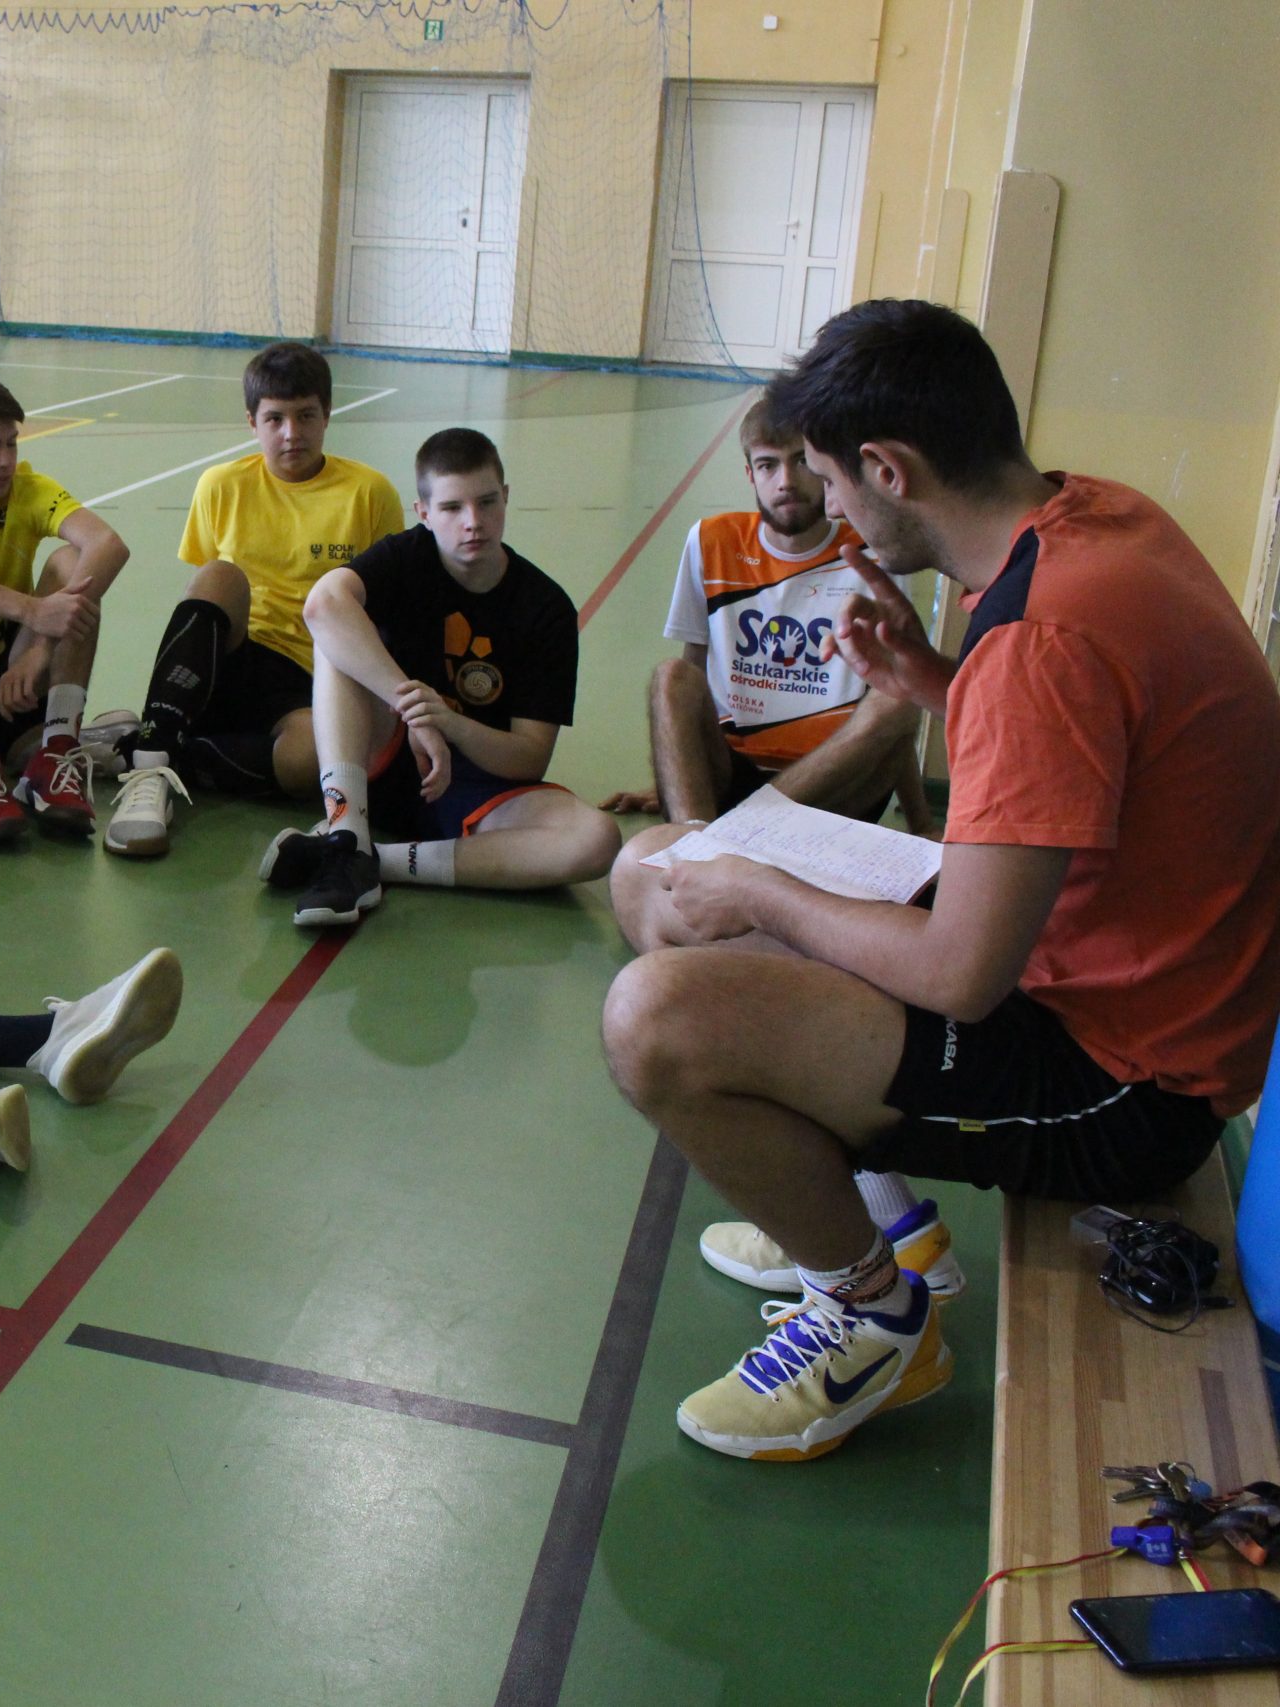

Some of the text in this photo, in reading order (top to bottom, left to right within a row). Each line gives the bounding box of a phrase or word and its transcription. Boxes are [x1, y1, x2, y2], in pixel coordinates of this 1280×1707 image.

[731, 657, 830, 684] siatkarskie
[730, 673, 828, 696] ośrodki szkolne
